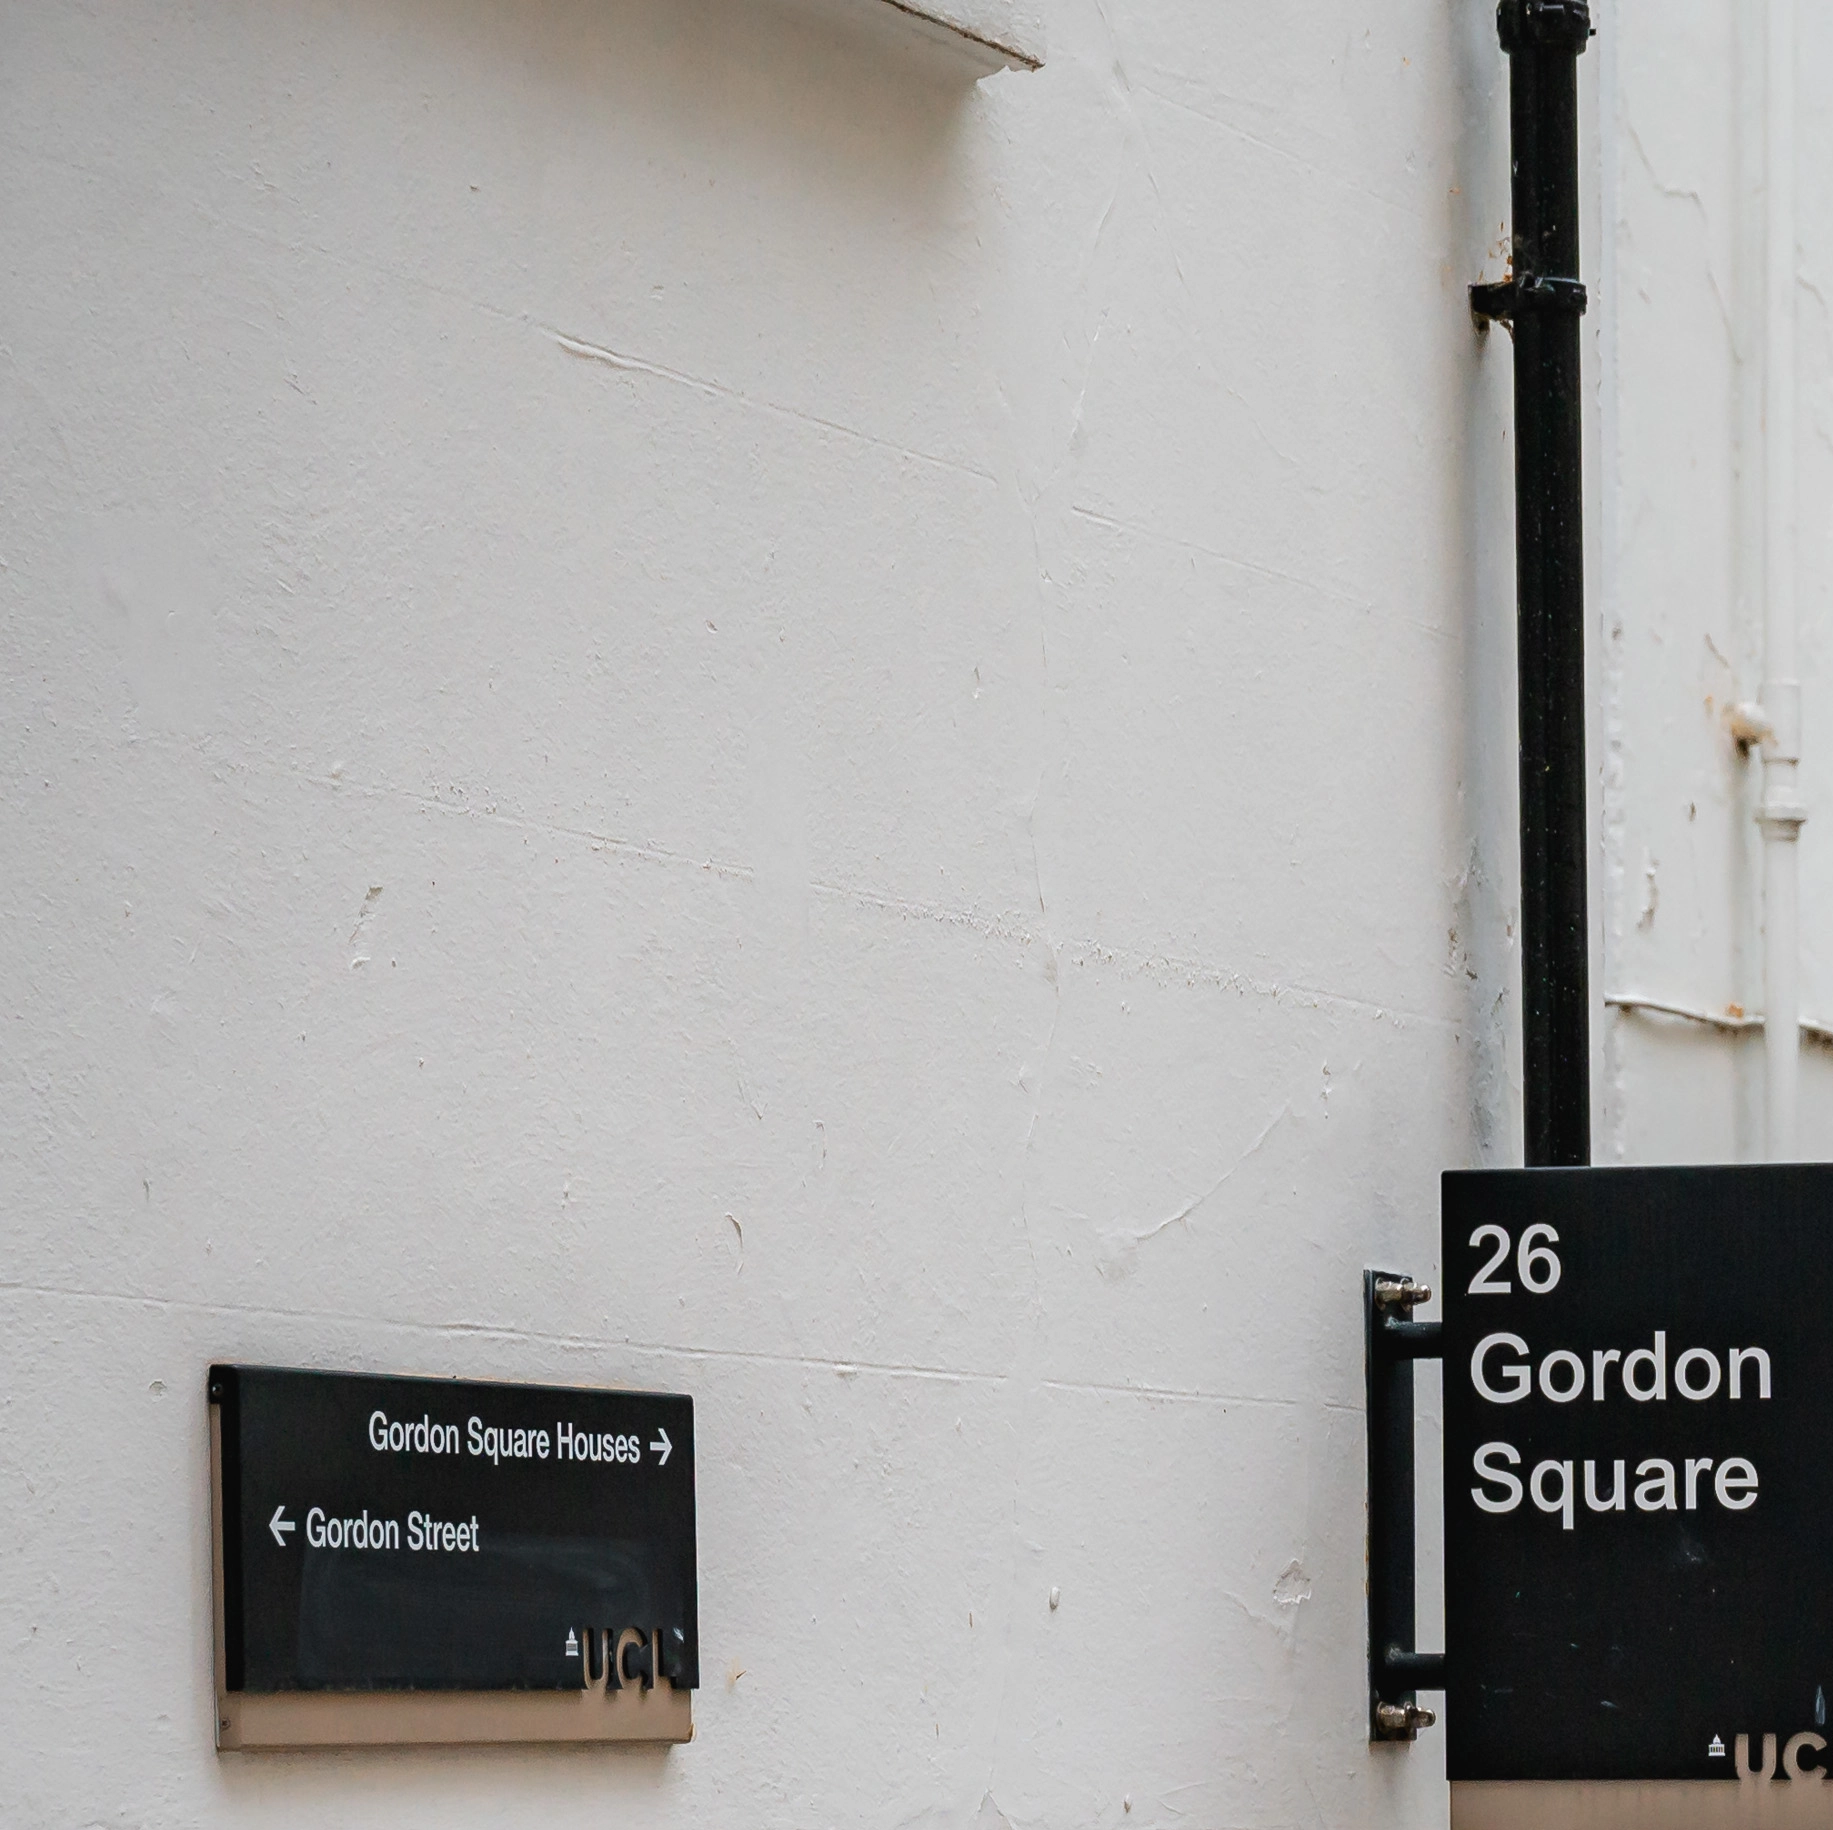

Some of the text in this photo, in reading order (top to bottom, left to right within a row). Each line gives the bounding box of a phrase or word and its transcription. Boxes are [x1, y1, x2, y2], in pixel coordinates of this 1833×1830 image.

[1467, 1223, 1562, 1295] 26
[1470, 1330, 1772, 1404] Gordon
[368, 1410, 641, 1466] Gordon Square Houses
[1470, 1441, 1759, 1531] Square
[306, 1506, 480, 1552] Gordon Street
[582, 1626, 671, 1689] UCL
